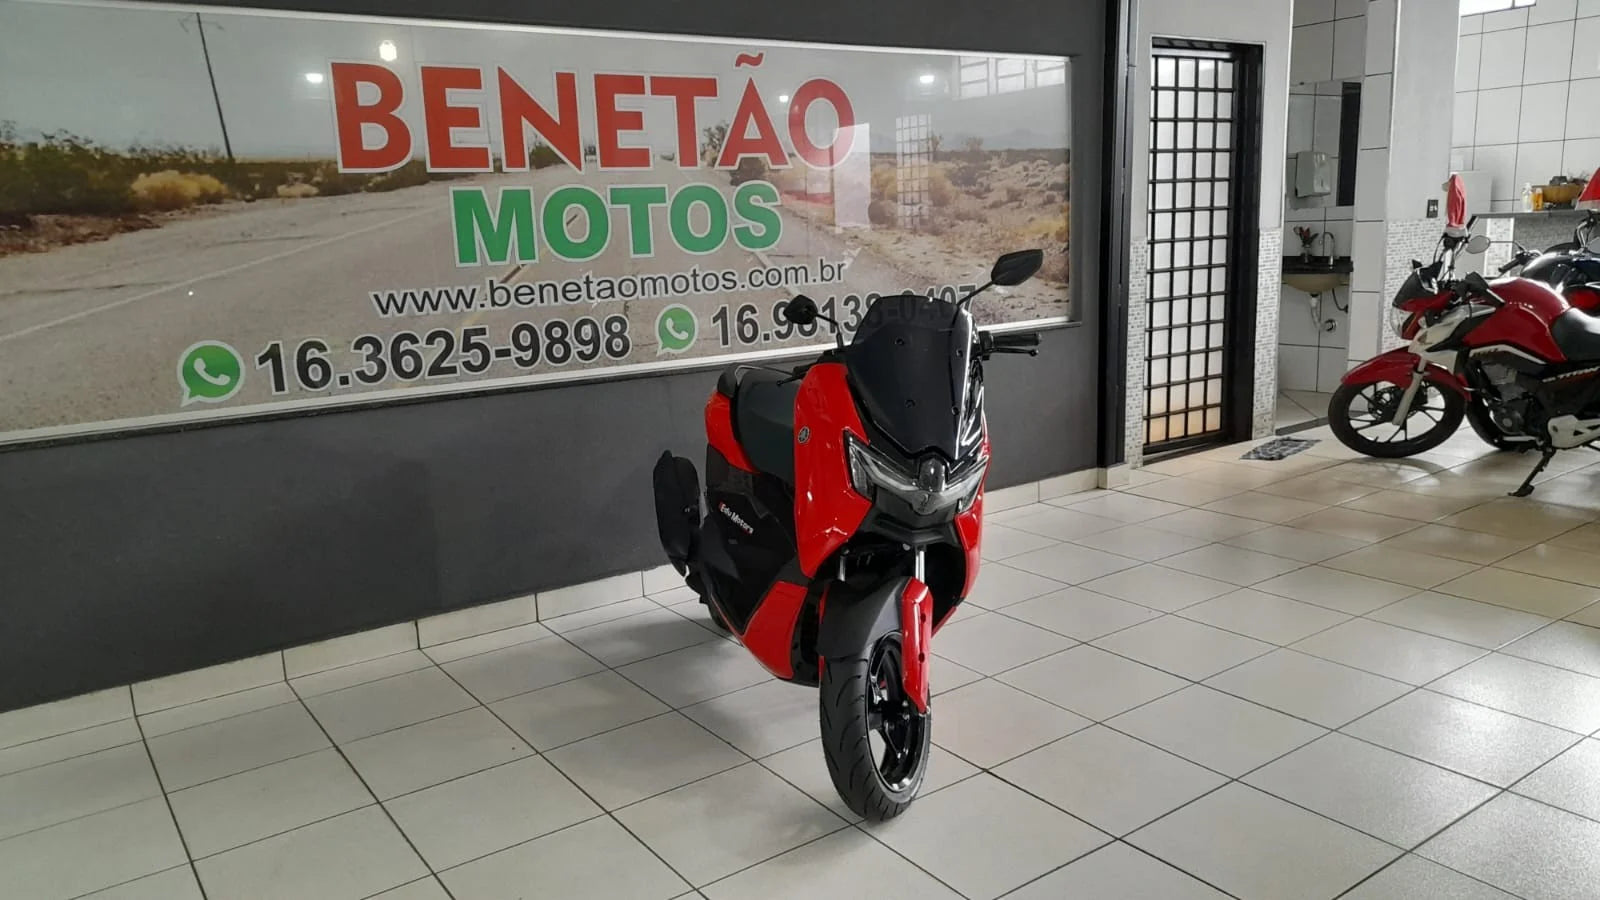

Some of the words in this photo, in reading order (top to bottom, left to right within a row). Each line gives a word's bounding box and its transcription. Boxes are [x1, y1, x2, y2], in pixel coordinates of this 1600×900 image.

[331, 53, 855, 172] BENETÃO
[452, 182, 782, 264] MOTOS
[373, 258, 846, 317] www.benetaomotos.com.br
[256, 314, 631, 394] 16.3625-9898
